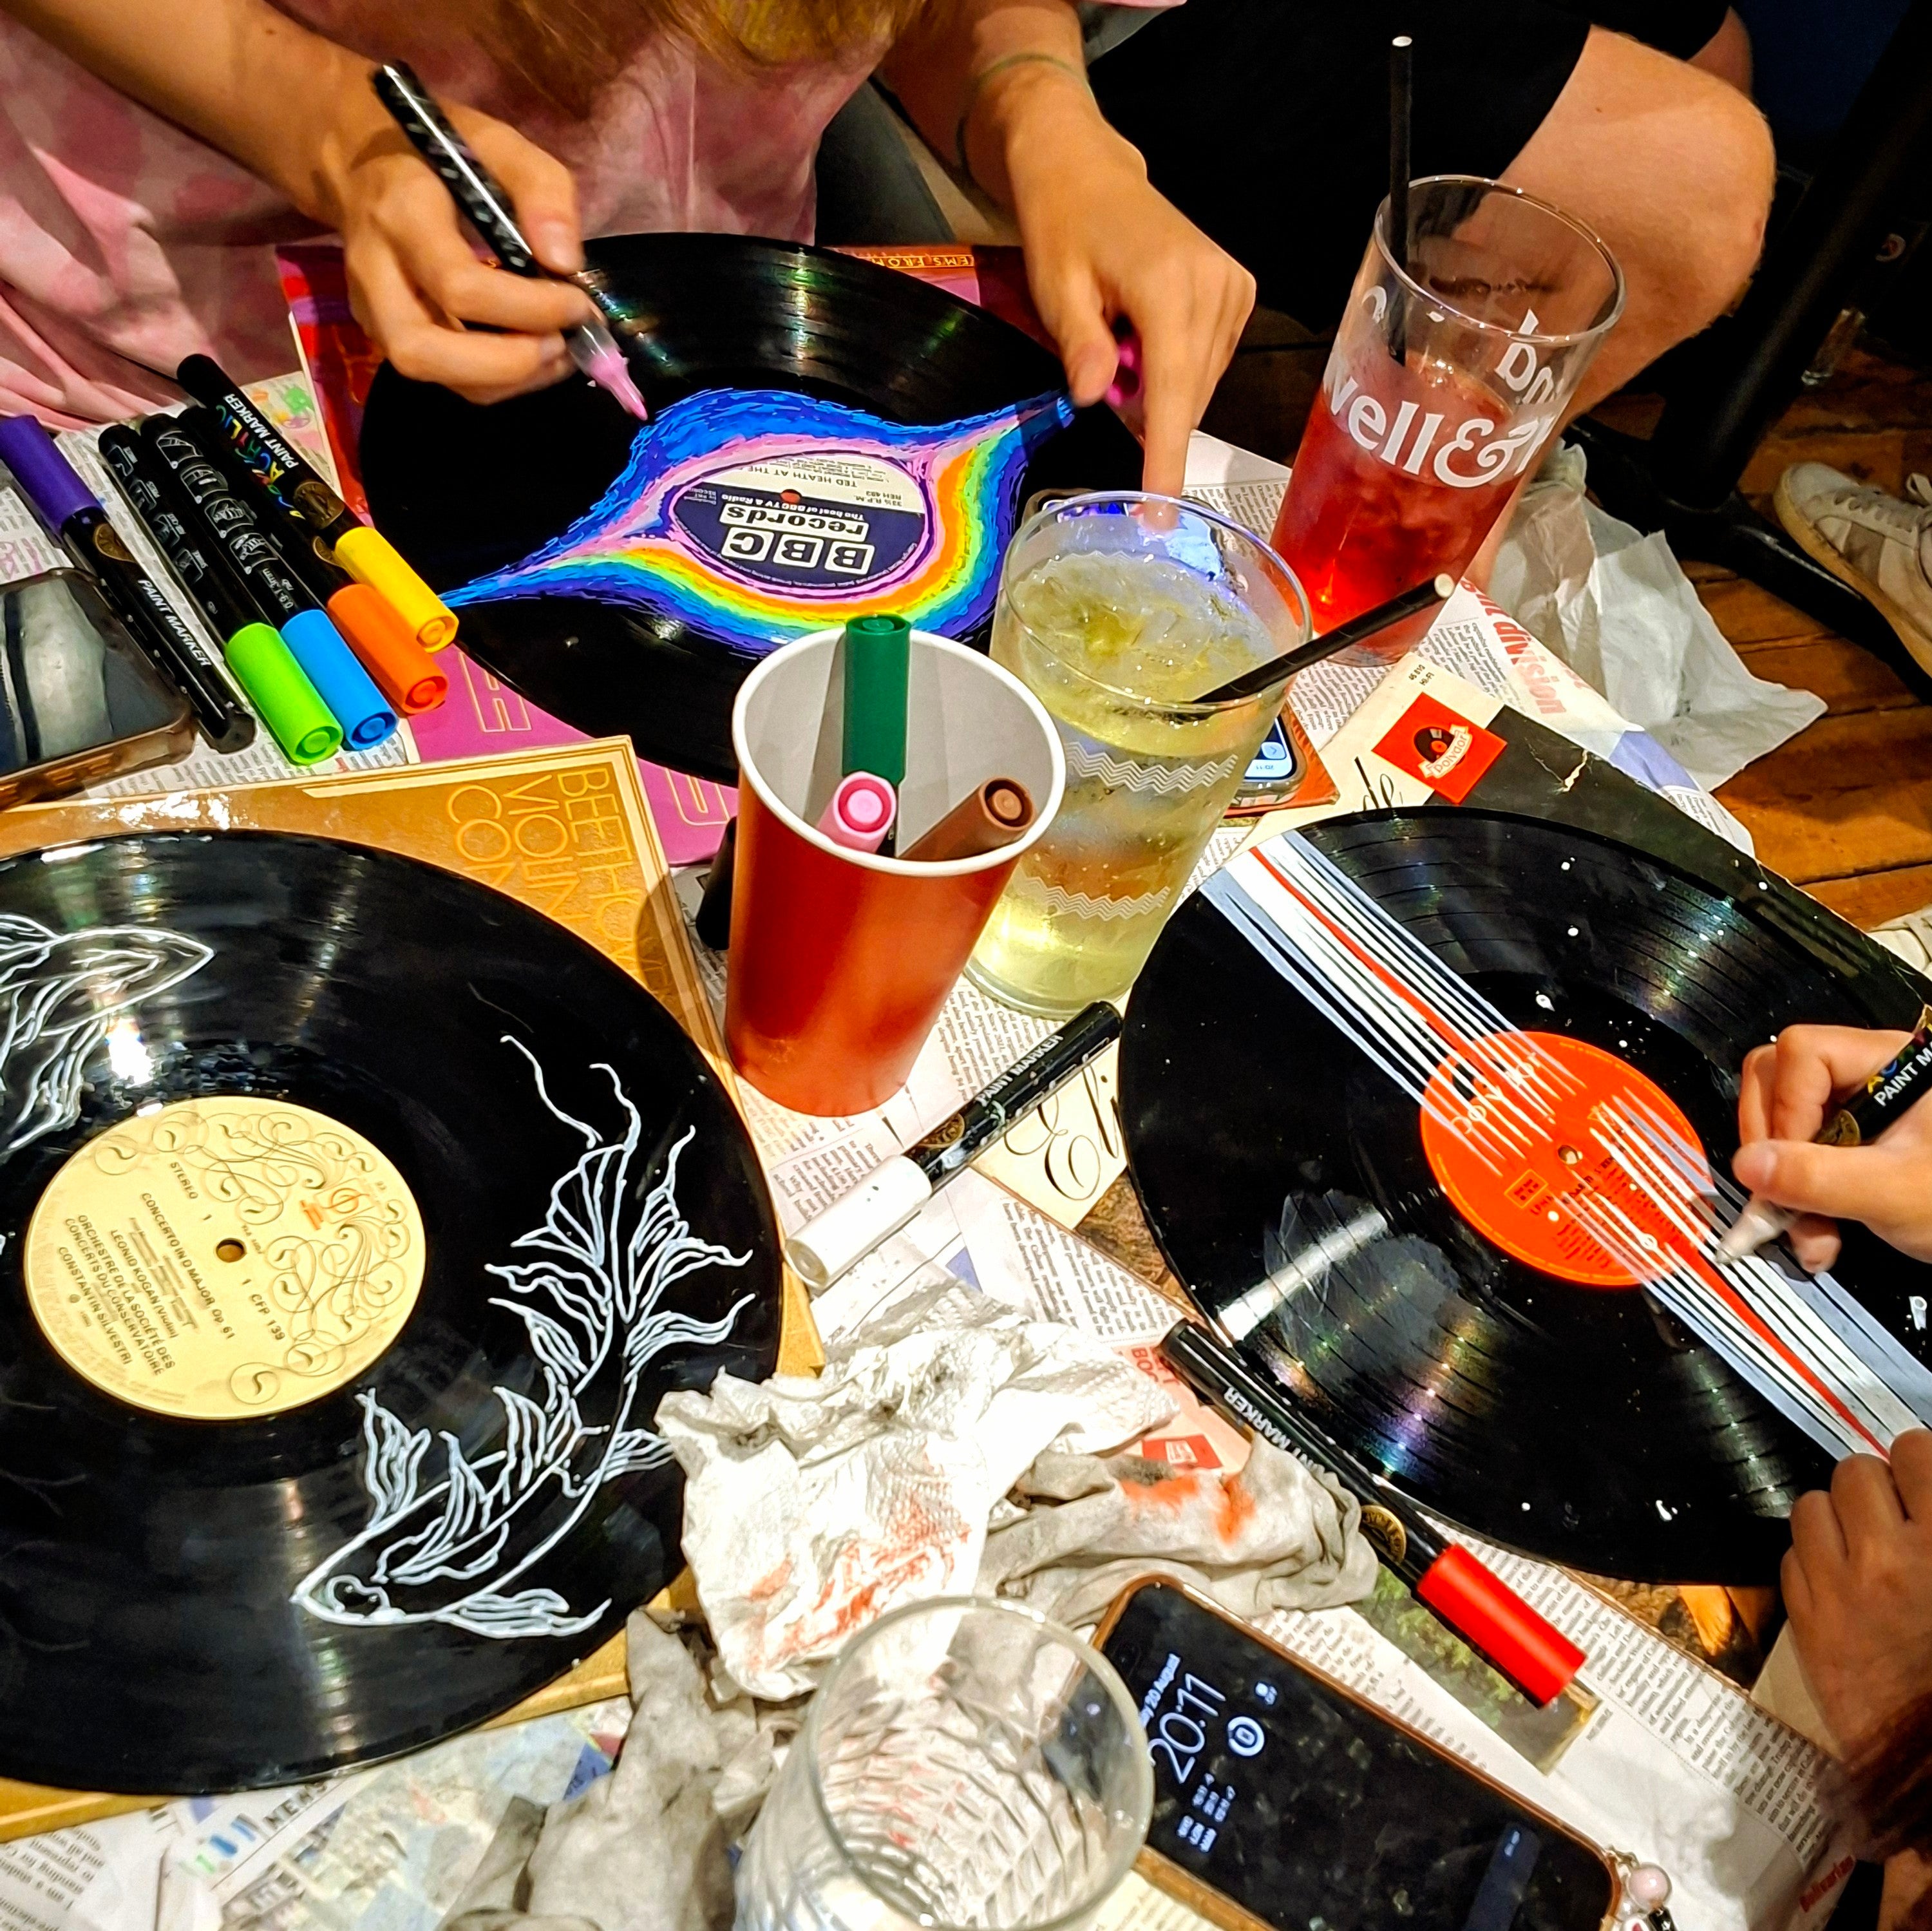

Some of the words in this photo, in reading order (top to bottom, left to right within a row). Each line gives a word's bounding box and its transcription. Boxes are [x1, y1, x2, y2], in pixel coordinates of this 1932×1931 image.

[222, 392, 270, 437] MARKER
[263, 437, 299, 468] PAINT
[773, 468, 789, 477] AT
[791, 471, 832, 484] HEATH
[835, 477, 858, 488] TED
[721, 492, 753, 504] Radio
[764, 499, 781, 508] TV
[806, 505, 817, 513] of
[723, 503, 866, 541] records
[844, 510, 864, 520] The
[722, 524, 873, 575] BBC
[137, 578, 173, 613] PAINT
[164, 614, 212, 667] MARKER
[958, 1021, 969, 1039] been
[974, 1014, 996, 1054] population
[987, 1012, 999, 1032] Since
[996, 1009, 1010, 1034] Cuban
[974, 1071, 1016, 1108] PAINT
[1009, 1031, 1065, 1078] MARKER
[1872, 1061, 1918, 1107] PAINT
[168, 1159, 200, 1201] STEREO
[138, 1190, 182, 1249] CONCERTO
[61, 1216, 104, 1274] CONCERTS
[174, 1245, 188, 1260] IN
[1029, 1243, 1046, 1271] Cuban
[108, 1227, 140, 1268] LEONID
[129, 1266, 162, 1306] KOGAN
[180, 1257, 194, 1270] D
[74, 1212, 122, 1276] ORCHESTRE
[112, 1273, 128, 1290] DE
[120, 1288, 136, 1304] LA
[128, 1300, 166, 1347] SOCIÉTÉ
[154, 1344, 177, 1371] DES
[95, 1271, 113, 1289] DU
[1076, 1277, 1088, 1295] and
[54, 1244, 106, 1314] CONSTANTIN
[93, 1309, 137, 1366] SILVESTRI
[249, 1291, 271, 1317] CFP
[265, 1318, 286, 1342] 139
[102, 1287, 167, 1378] CONSERVATOIRE
[221, 1324, 235, 1340] 61
[1223, 1385, 1291, 1451] MARKER
[1142, 1688, 1162, 1707] 20
[1139, 1669, 1229, 1786] 20:11
